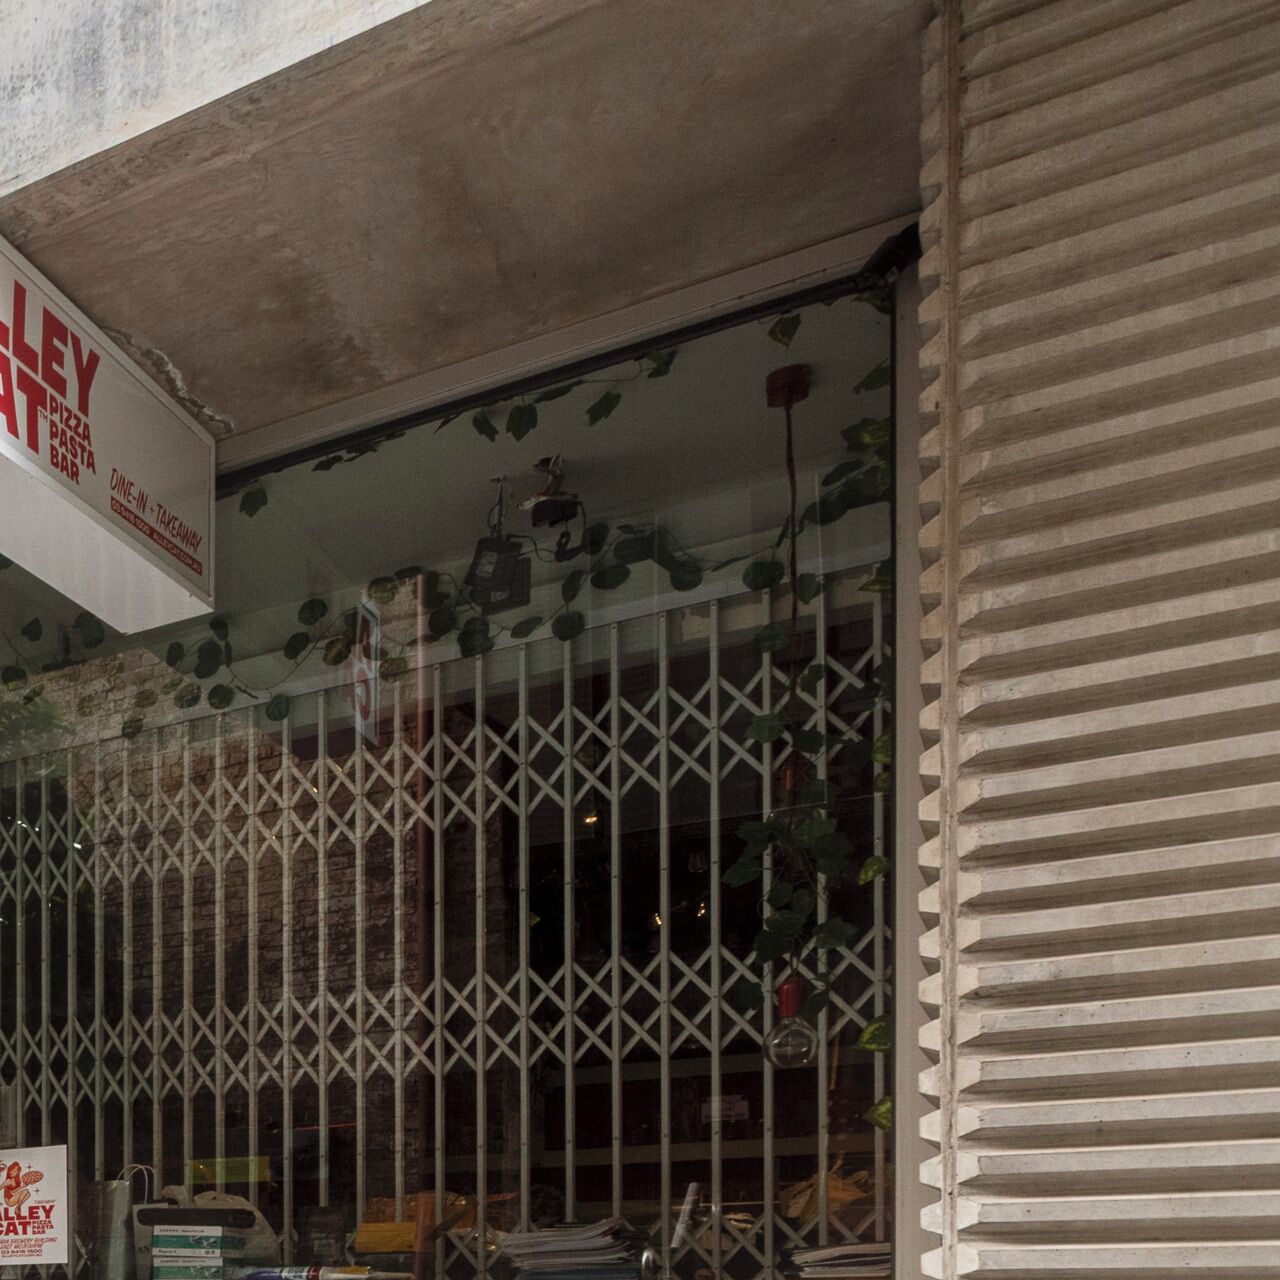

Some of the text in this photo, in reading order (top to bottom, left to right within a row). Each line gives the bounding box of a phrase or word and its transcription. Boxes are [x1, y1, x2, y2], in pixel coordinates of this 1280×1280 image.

[49, 392, 93, 448] PIZZA
[49, 418, 97, 475] PASTA
[49, 443, 80, 486] BAR
[110, 468, 149, 514] DINE-IN
[156, 502, 203, 554] TAKEAWAY
